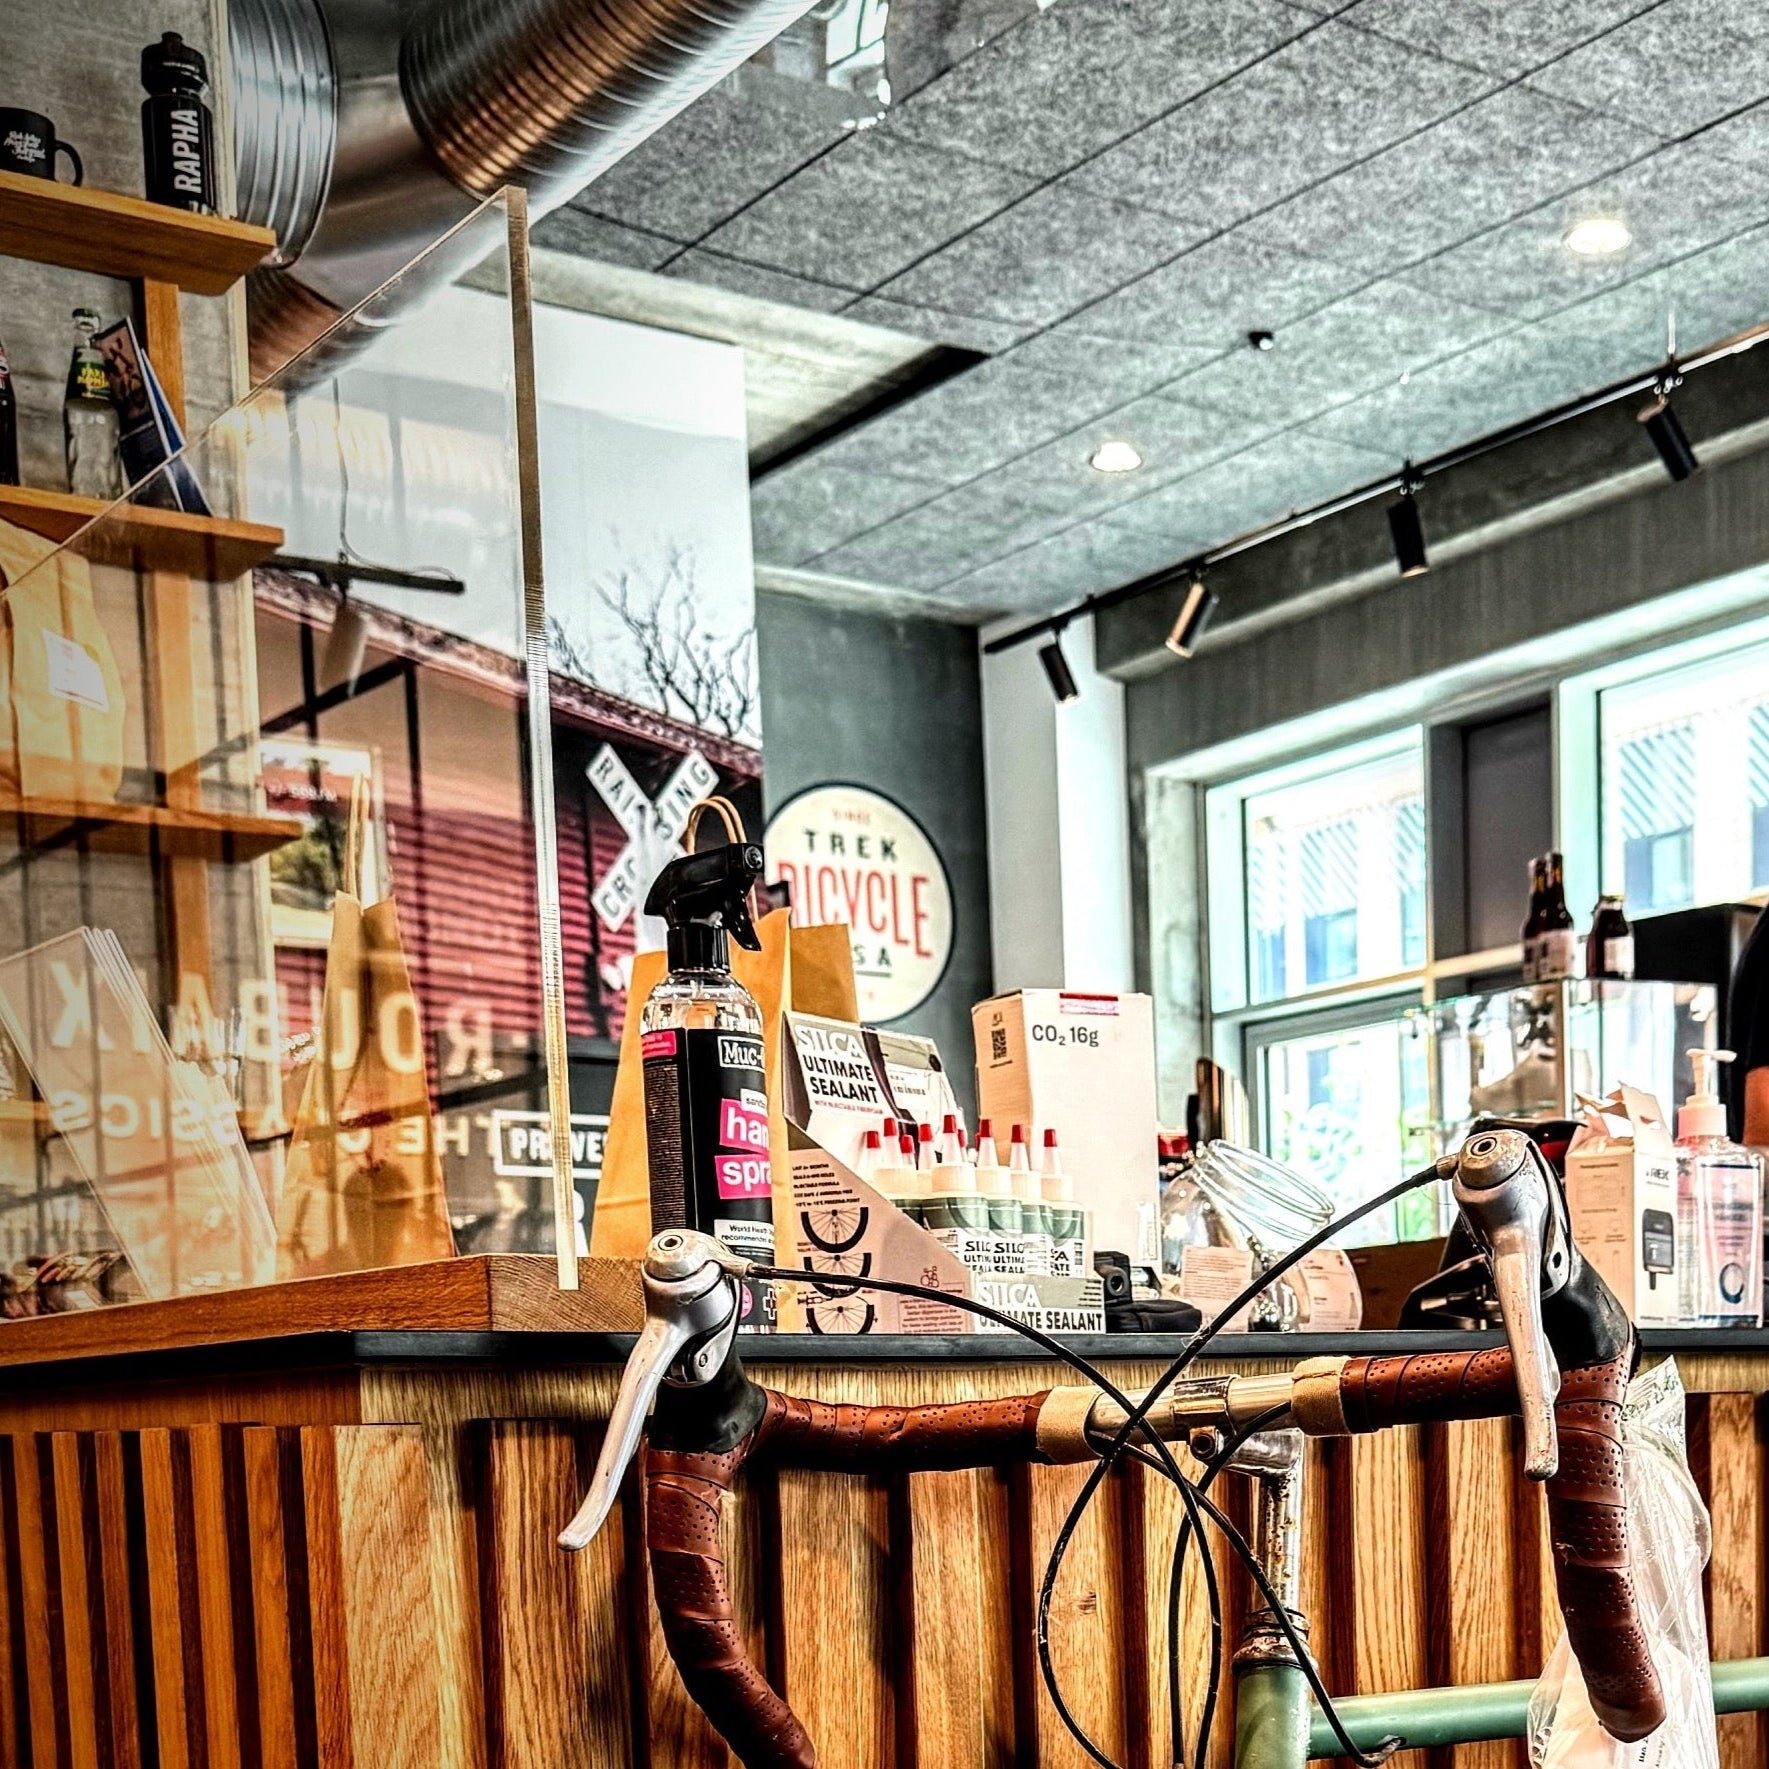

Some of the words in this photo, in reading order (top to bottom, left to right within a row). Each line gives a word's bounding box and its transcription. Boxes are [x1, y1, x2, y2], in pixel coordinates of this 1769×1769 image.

[170, 109, 202, 194] RAPHA
[804, 830, 899, 863] TREK
[853, 944, 893, 967] SA
[1069, 1026, 1099, 1047] 16g
[802, 1053, 874, 1082] ULTIMATE
[809, 1076, 879, 1104] SEALANT
[1046, 1310, 1103, 1331] SEALANT
